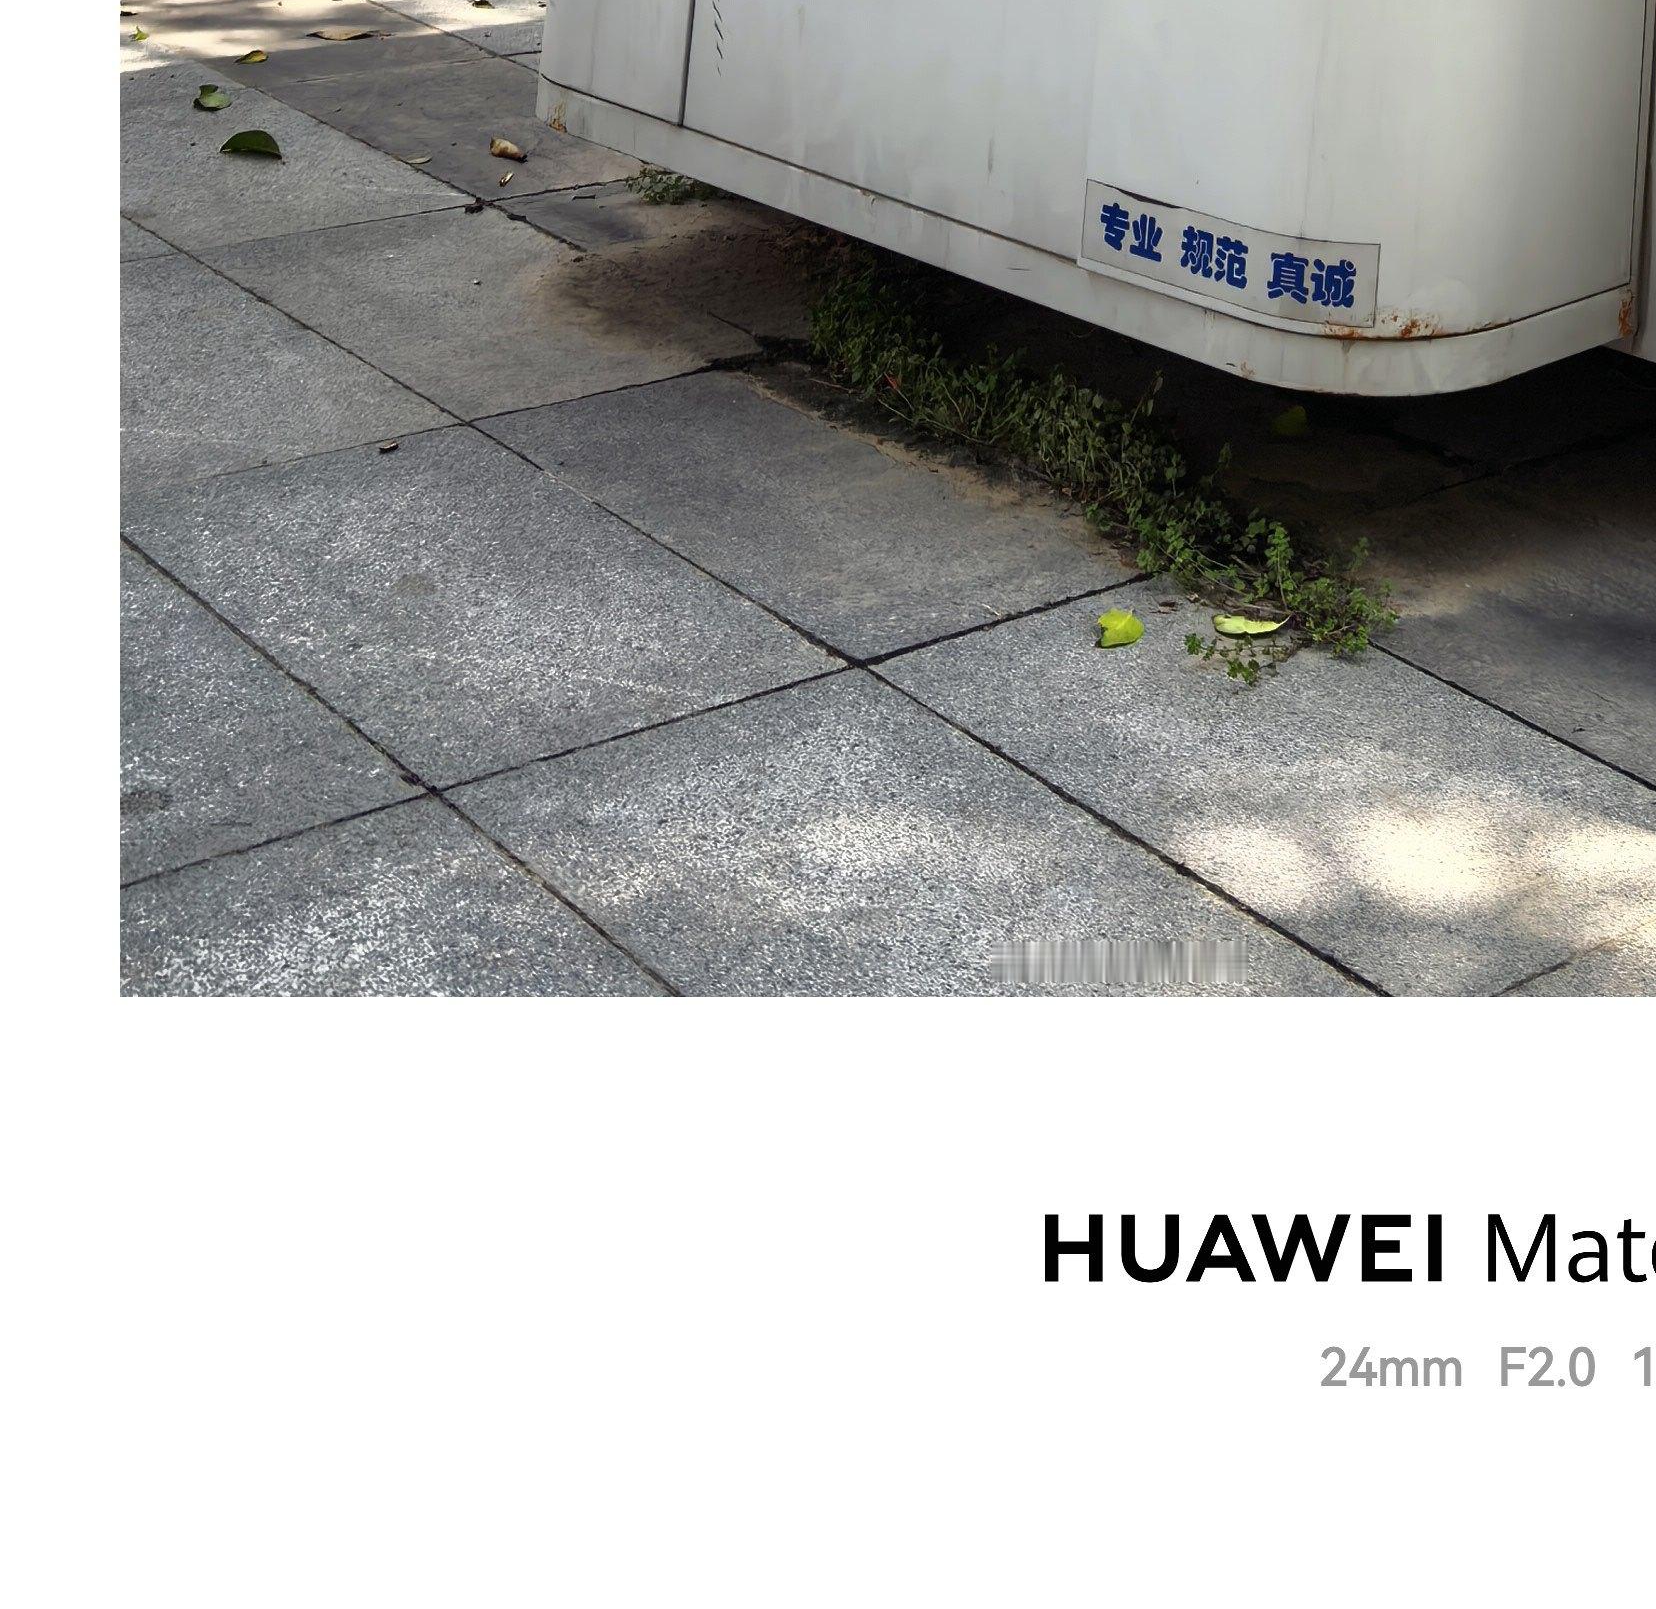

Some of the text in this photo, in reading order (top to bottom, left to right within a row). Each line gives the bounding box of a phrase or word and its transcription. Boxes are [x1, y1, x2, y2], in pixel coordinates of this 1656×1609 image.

[1100, 202, 1357, 308] 专业 规范 真诚
